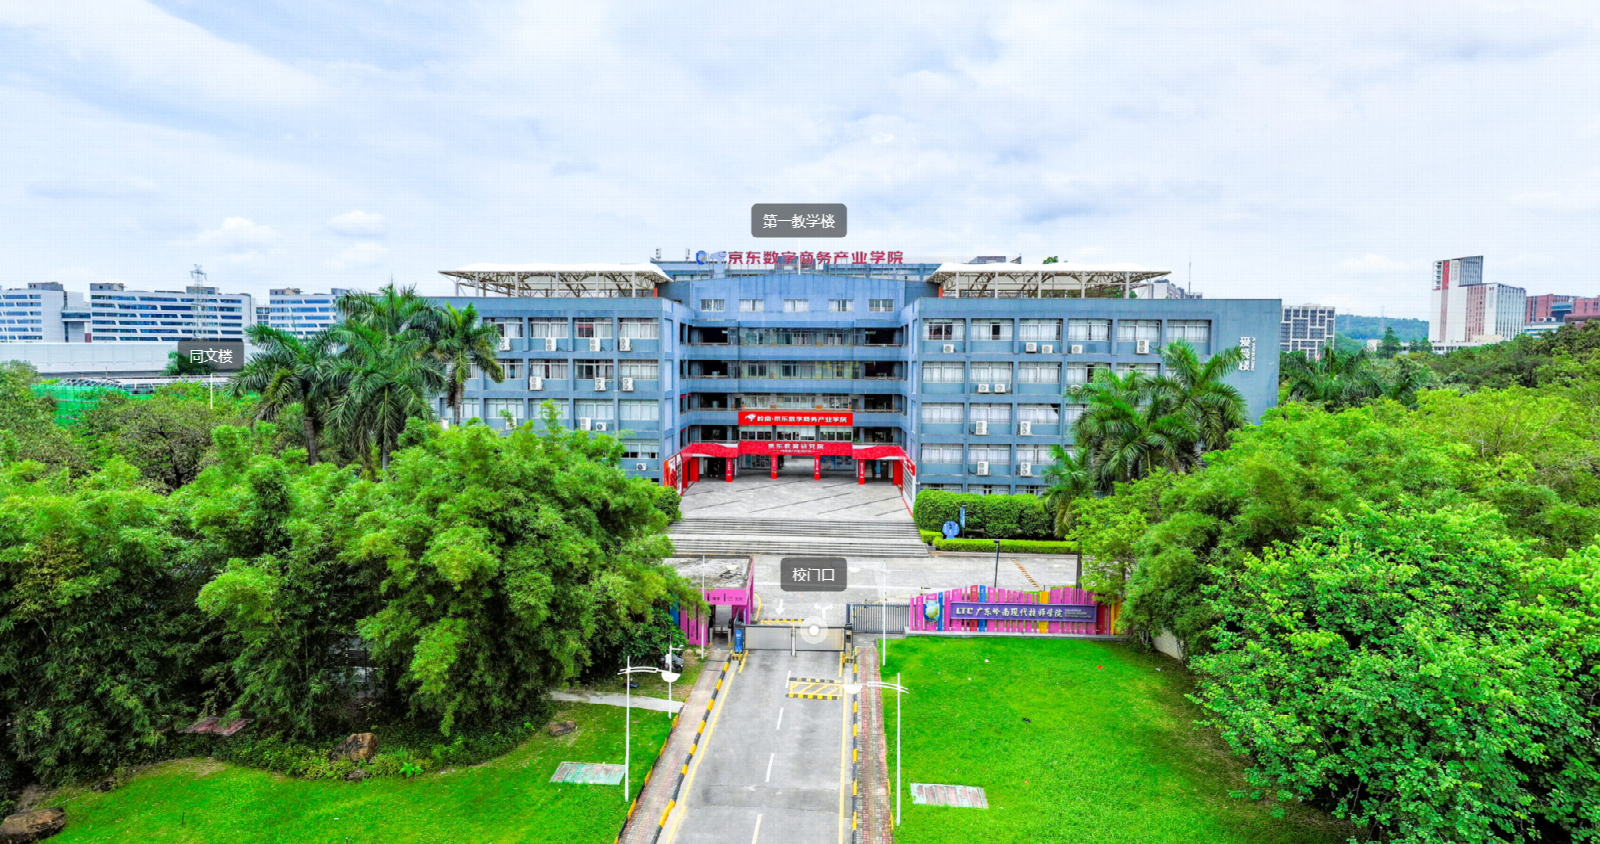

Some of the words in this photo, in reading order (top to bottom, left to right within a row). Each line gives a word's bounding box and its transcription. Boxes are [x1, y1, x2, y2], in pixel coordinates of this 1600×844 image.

[727, 251, 904, 265] 京东数字商务产业学院
[956, 607, 974, 615] LTC
[975, 606, 1063, 618] 广东岭南现代技师学院
